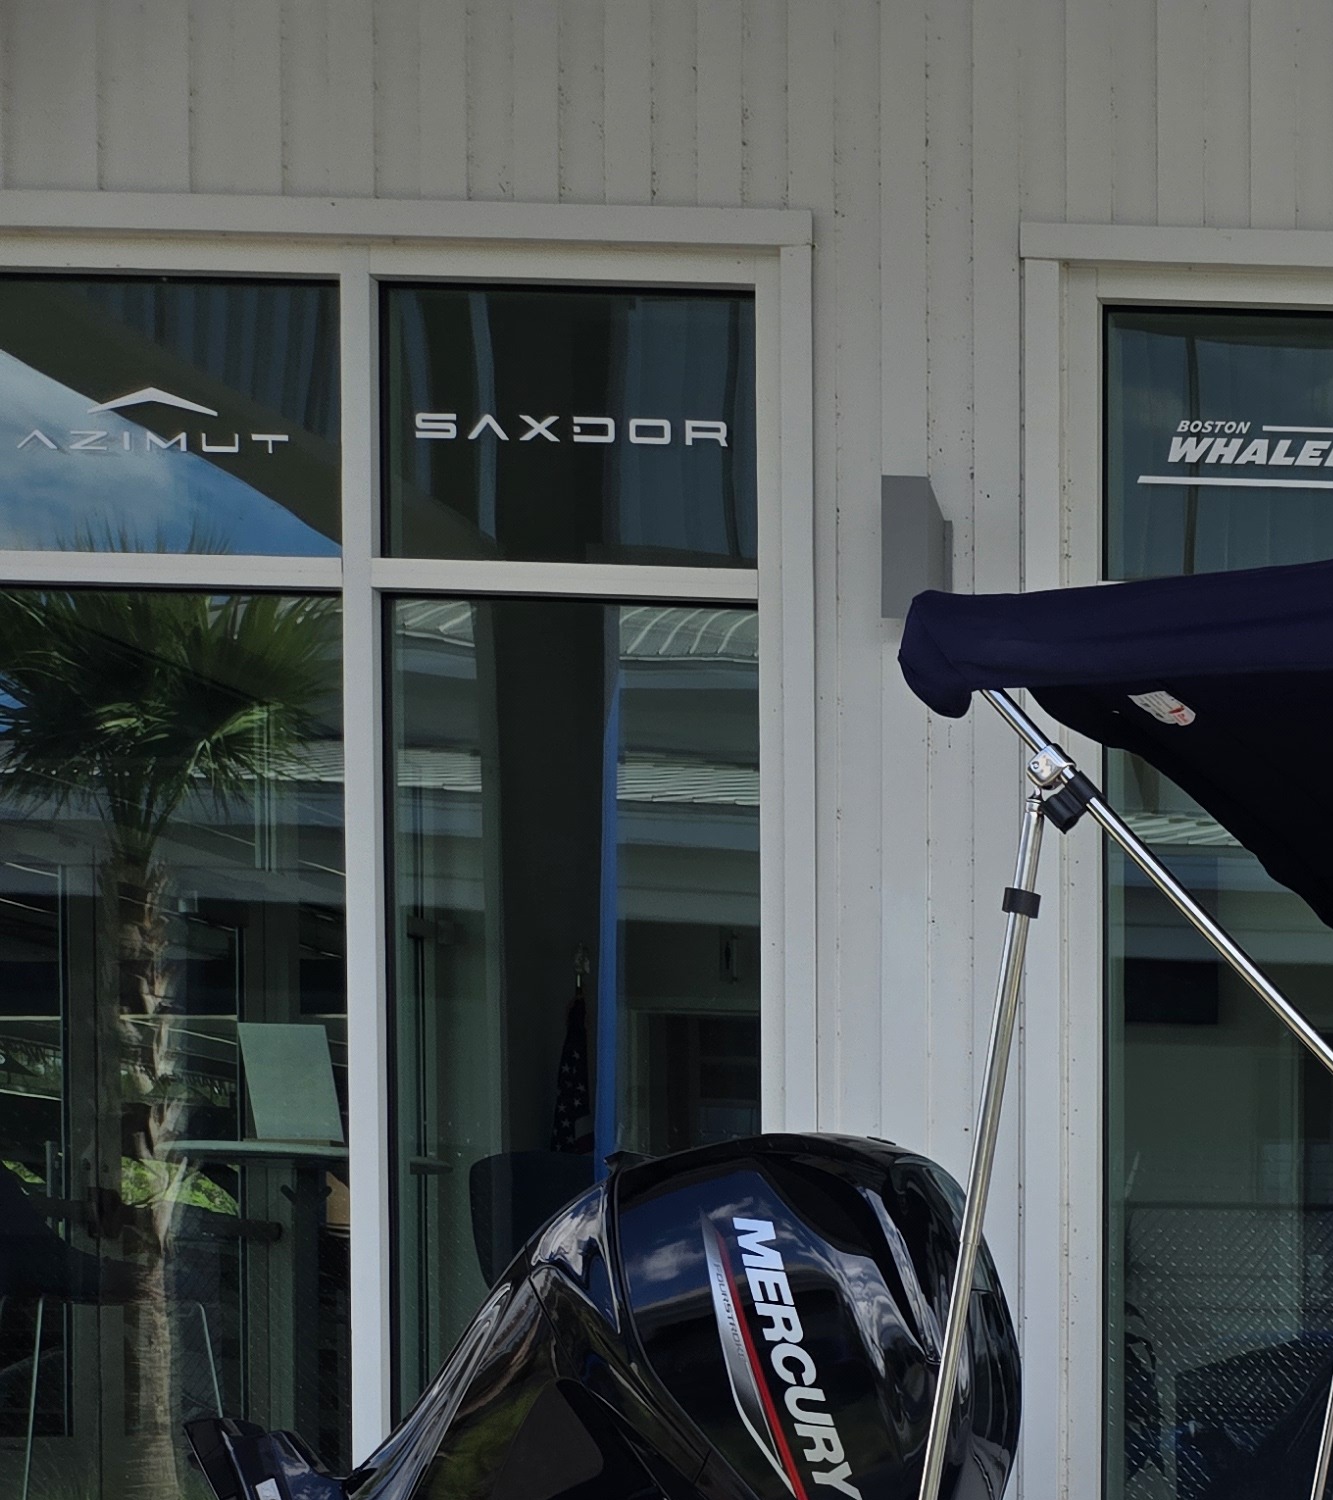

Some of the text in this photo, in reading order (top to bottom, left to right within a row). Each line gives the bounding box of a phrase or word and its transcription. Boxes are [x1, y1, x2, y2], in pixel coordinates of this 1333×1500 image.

[17, 430, 290, 455] AZIMUT
[414, 412, 729, 448] SAXDOR
[1176, 420, 1251, 435] BOSTON
[714, 1262, 746, 1363] FOURSTROKE
